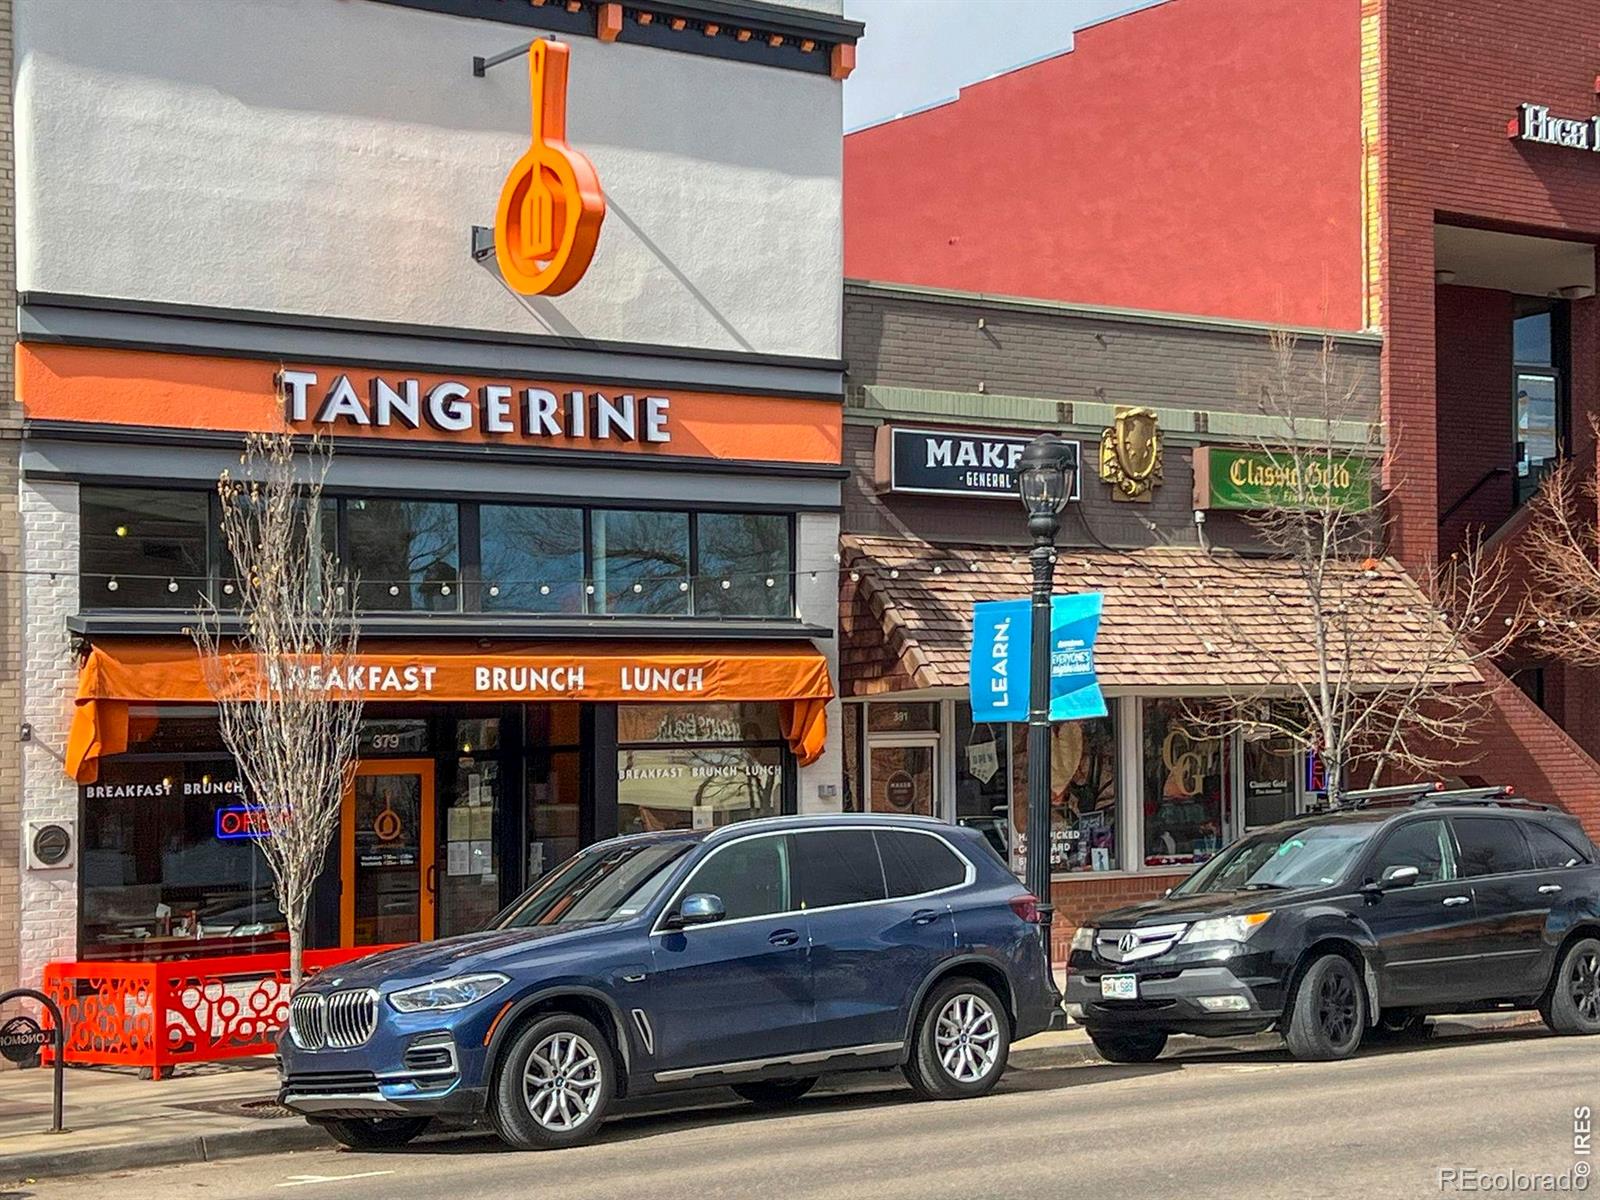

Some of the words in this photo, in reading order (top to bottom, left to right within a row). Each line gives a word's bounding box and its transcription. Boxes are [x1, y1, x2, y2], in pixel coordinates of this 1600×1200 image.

[278, 369, 671, 443] TANGERINE
[925, 438, 1026, 469] MAKE
[991, 617, 1012, 707] LEARN.
[474, 666, 584, 691] BRUNCH
[620, 667, 704, 691] LUNCH
[372, 734, 399, 748] 379
[618, 768, 683, 780] BREAKFAST
[692, 766, 737, 778] BRUNCH
[746, 765, 782, 776] LUNCH
[86, 784, 172, 799] BREAKFAST
[183, 780, 243, 795] BRUNCH
